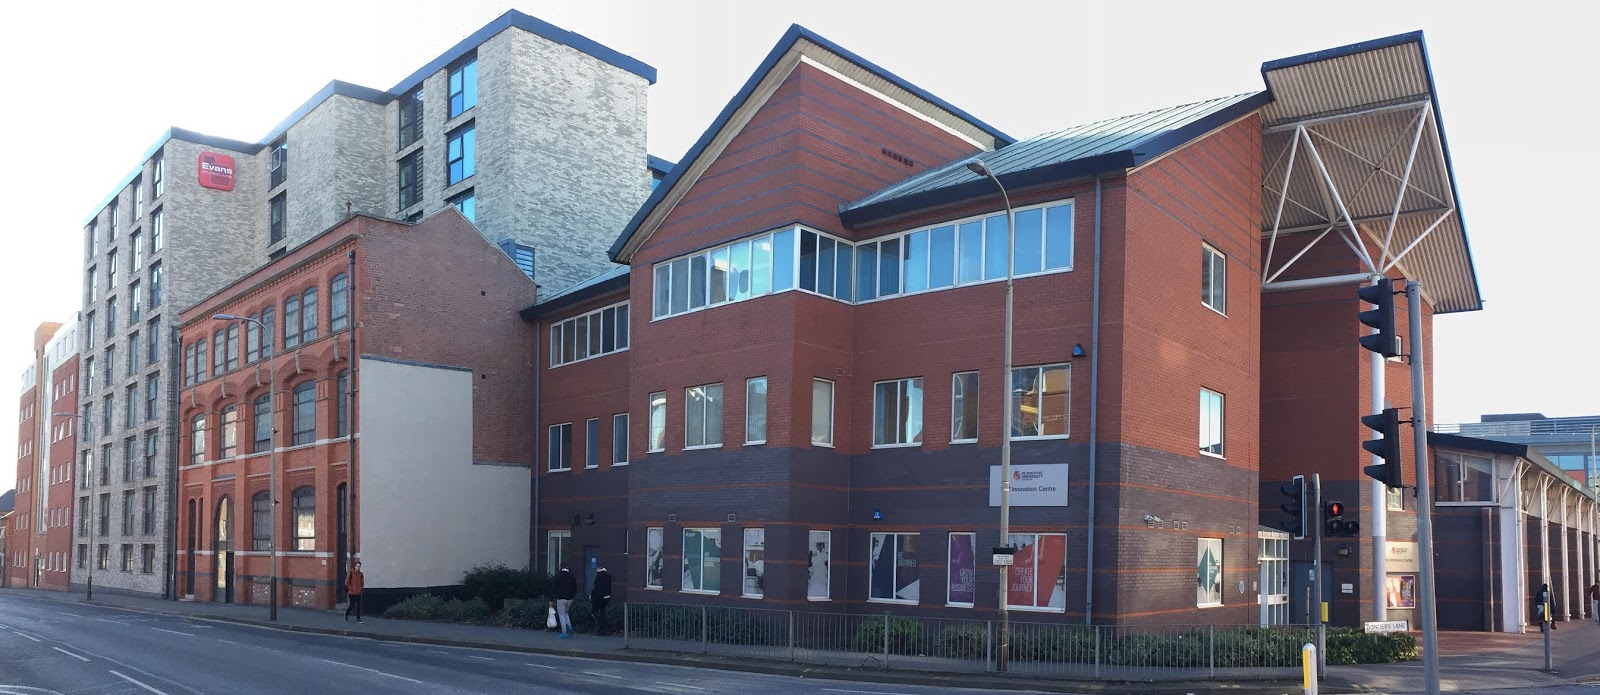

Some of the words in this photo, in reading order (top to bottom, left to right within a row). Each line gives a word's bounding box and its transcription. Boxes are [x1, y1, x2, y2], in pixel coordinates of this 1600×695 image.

[202, 162, 232, 174] Evans
[960, 568, 974, 576] GROW
[1015, 567, 1032, 575] CREATE
[952, 583, 974, 592] BUSINESS
[1011, 583, 1032, 592] JOURNEY
